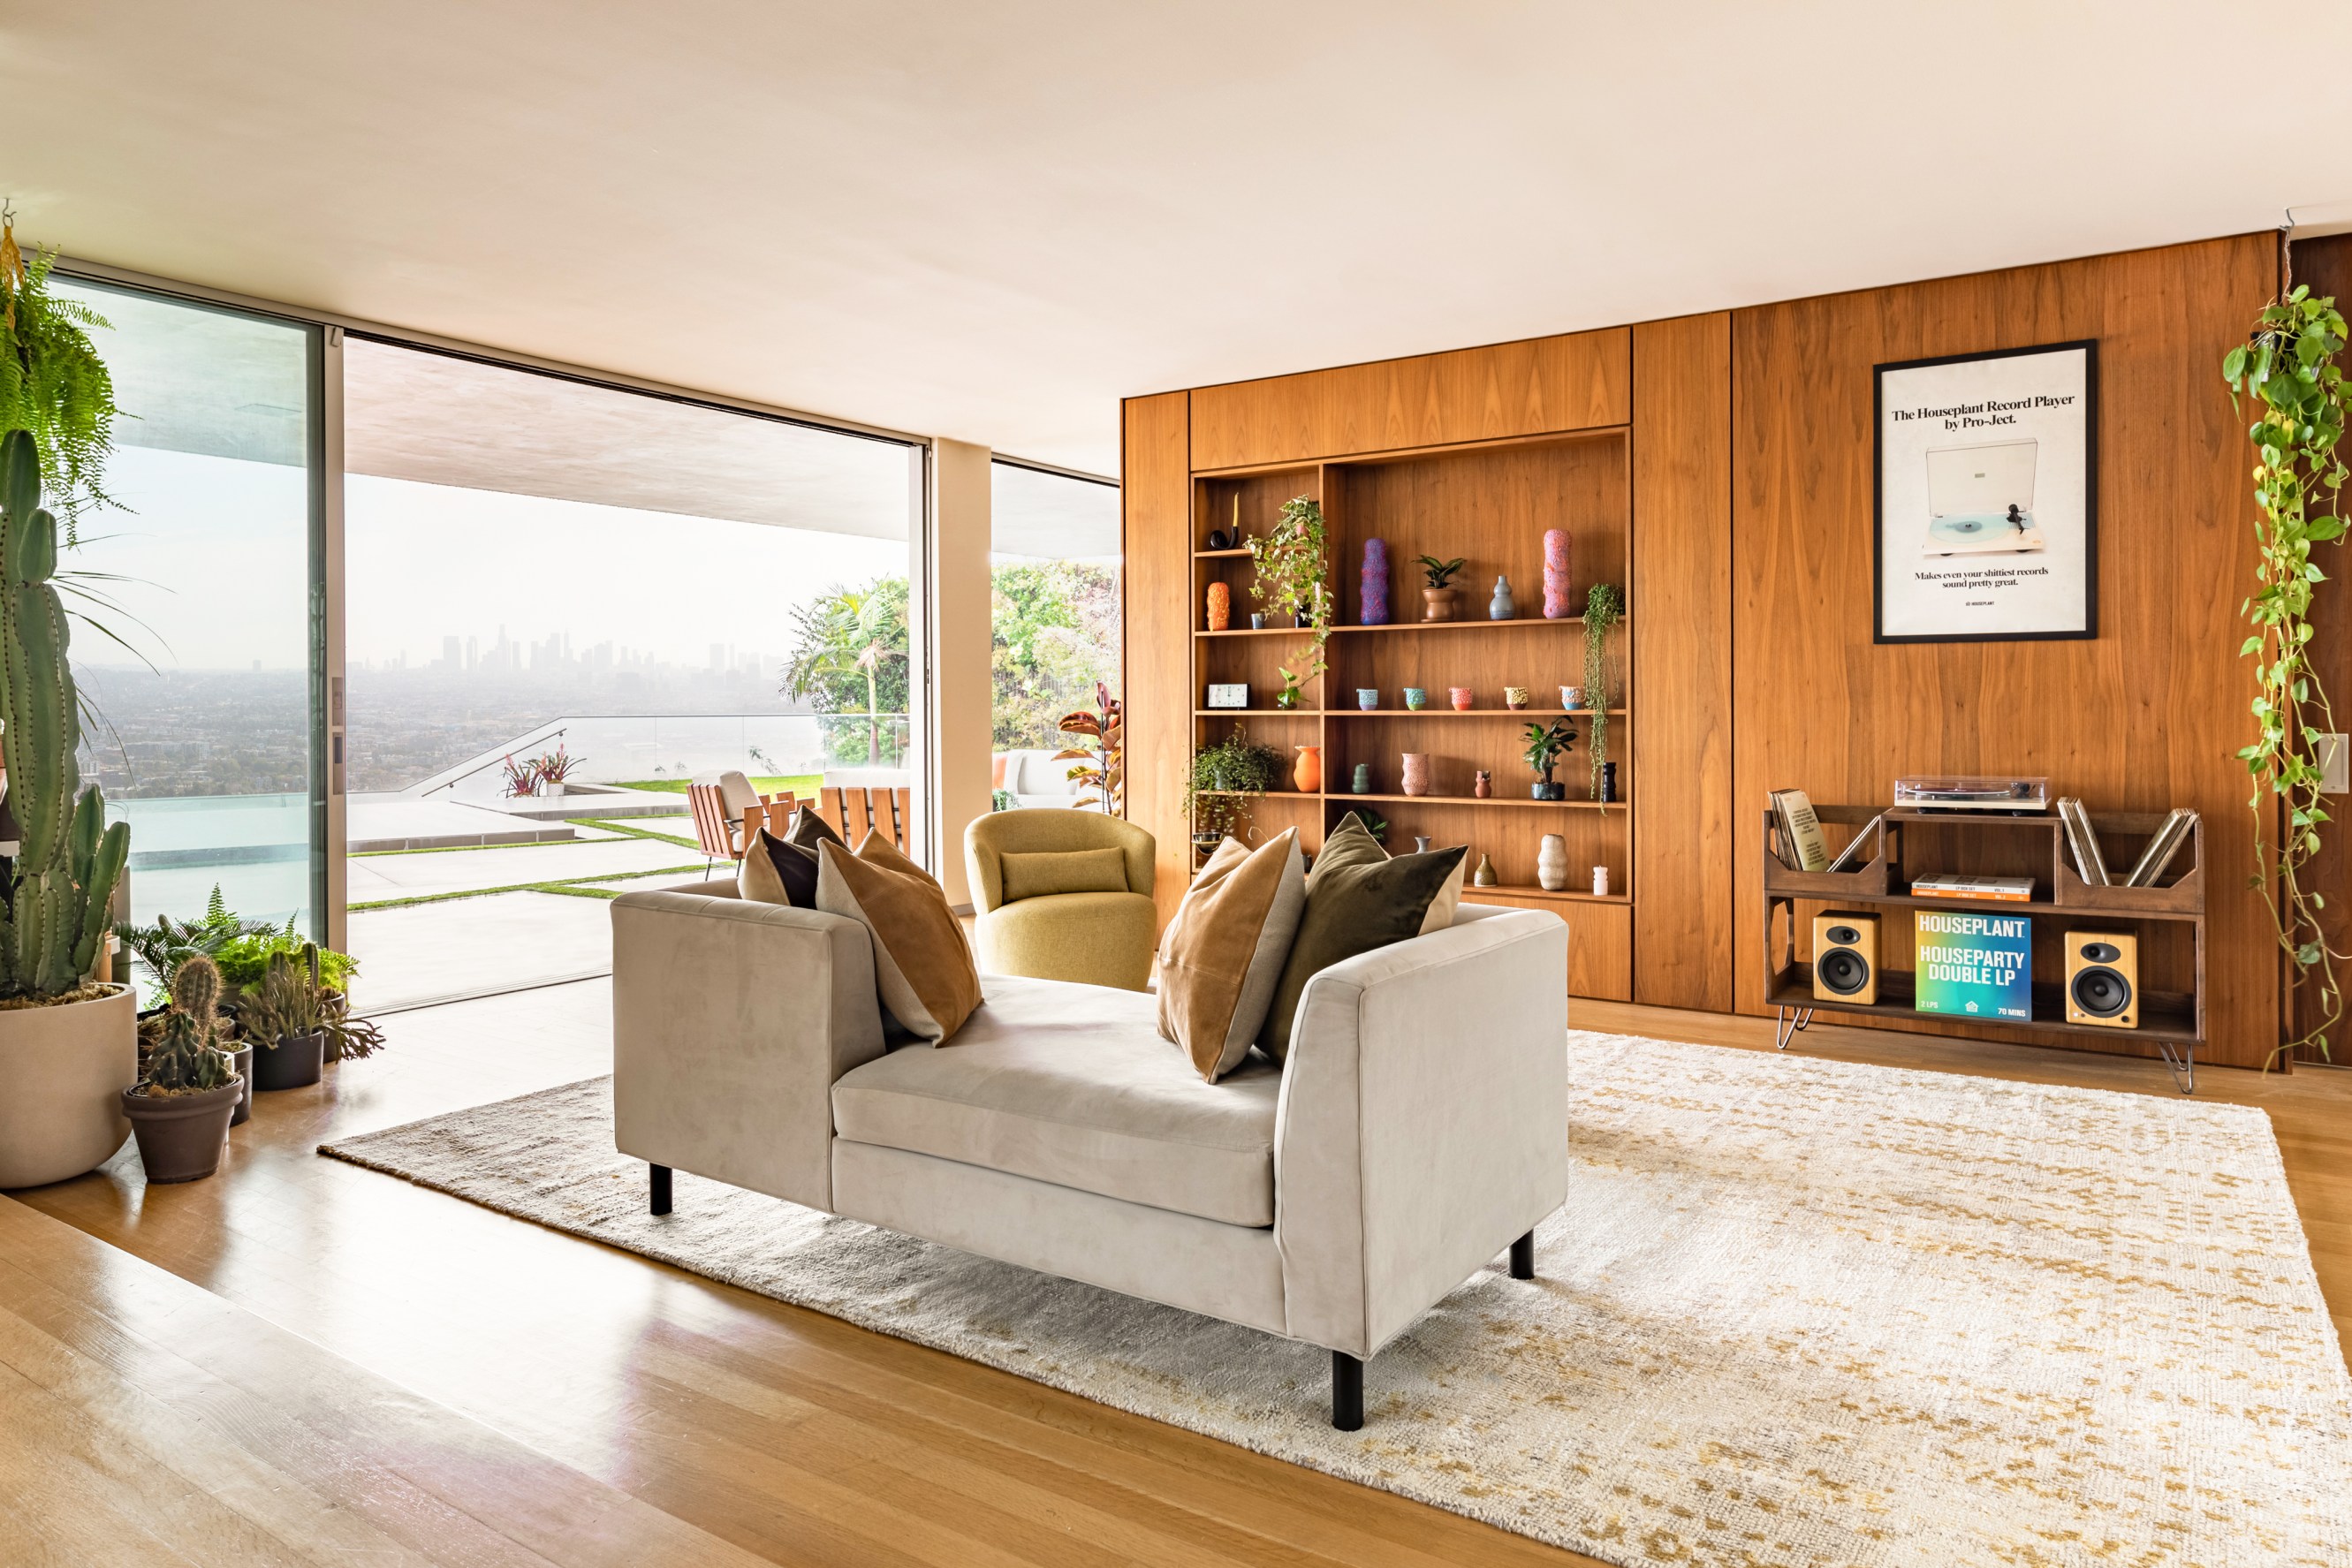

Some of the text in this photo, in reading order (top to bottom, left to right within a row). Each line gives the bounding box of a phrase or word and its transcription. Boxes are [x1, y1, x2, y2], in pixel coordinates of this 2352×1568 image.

[1892, 395, 2075, 421] The Houseplant Record Player
[1945, 414, 2016, 432] by Pro-Ject.
[1915, 572, 1942, 580] Makes
[1963, 571, 1983, 579] your
[1984, 568, 2015, 577] shittiest
[1942, 579, 2018, 589] sound pretty great.
[1919, 915, 2025, 937] HOUSEPLANT
[1920, 945, 2024, 968] HOUSEPARTY
[1929, 964, 2015, 986] DOUBLE LP
